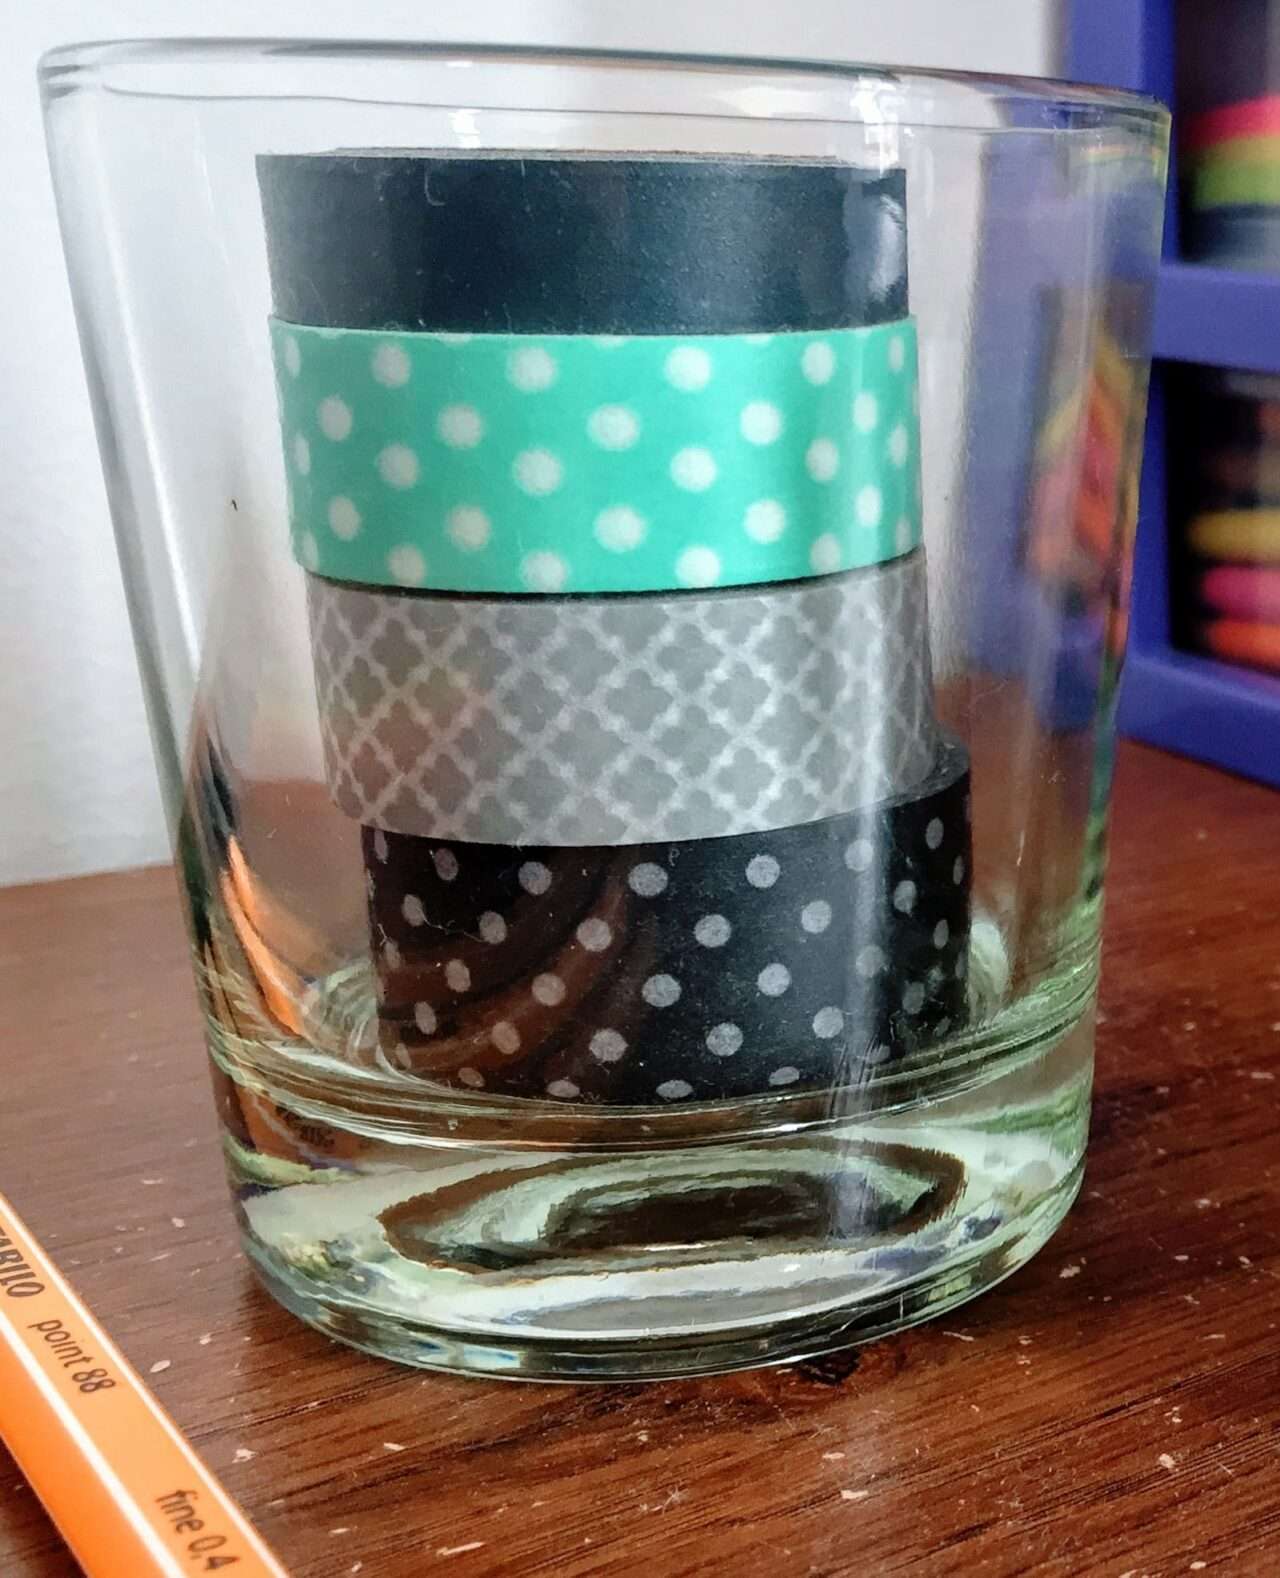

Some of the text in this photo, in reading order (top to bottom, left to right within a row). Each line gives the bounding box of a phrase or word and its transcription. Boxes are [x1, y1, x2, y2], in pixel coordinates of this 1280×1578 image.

[27, 1319, 94, 1368] point
[71, 1368, 116, 1393] 88
[155, 1489, 205, 1534] fine
